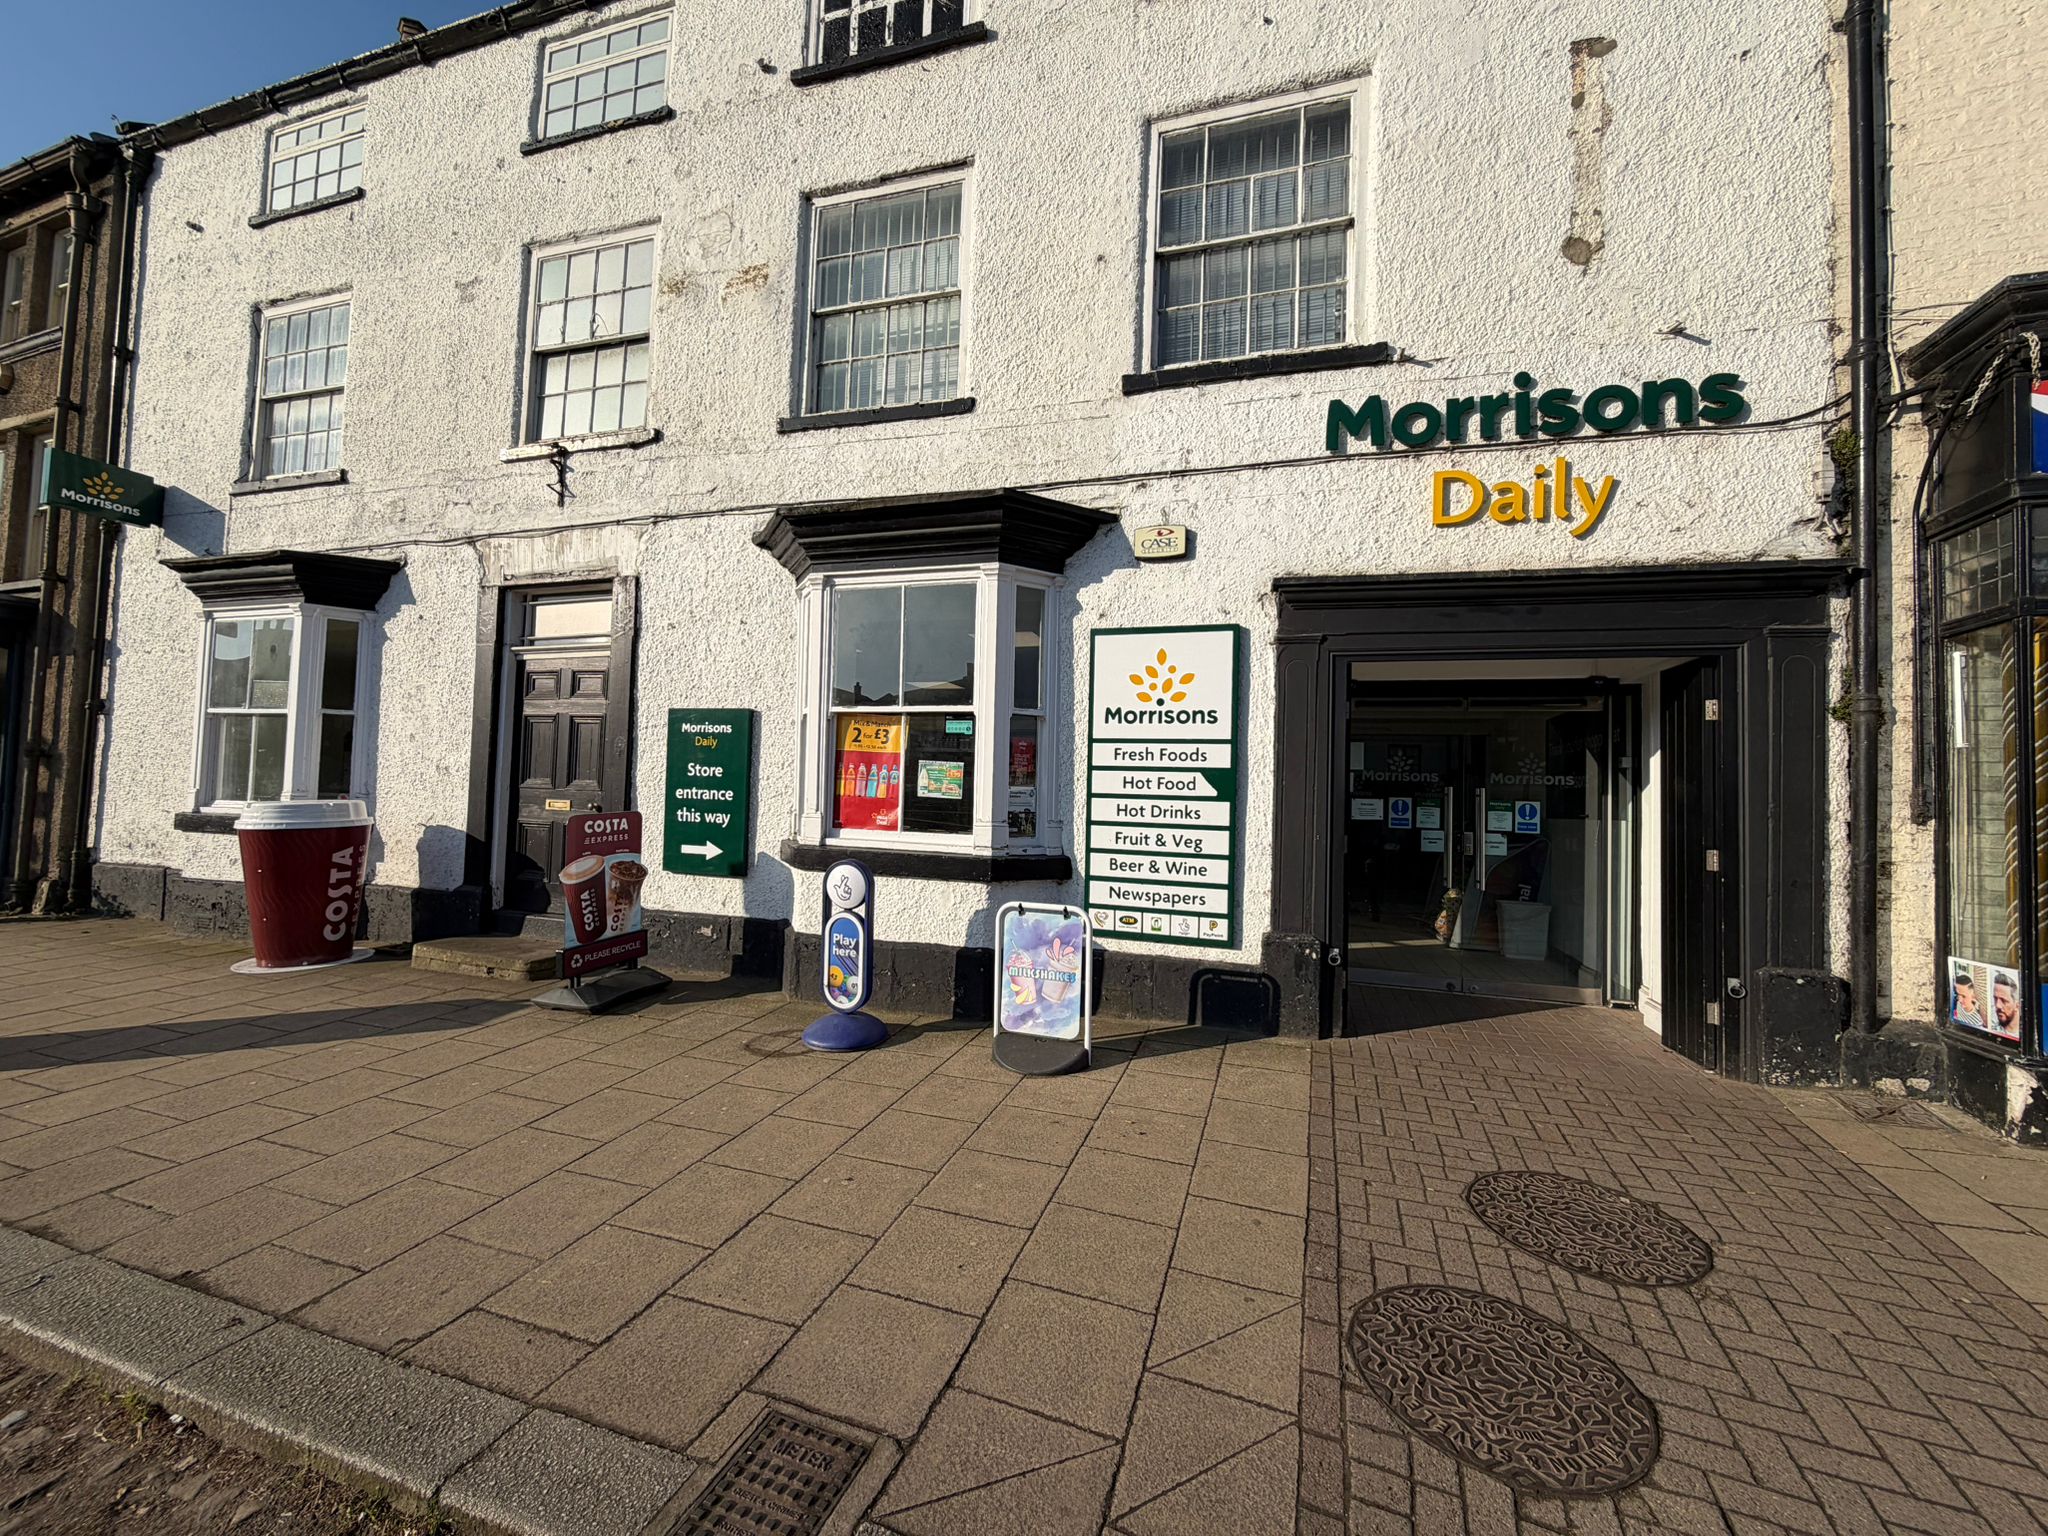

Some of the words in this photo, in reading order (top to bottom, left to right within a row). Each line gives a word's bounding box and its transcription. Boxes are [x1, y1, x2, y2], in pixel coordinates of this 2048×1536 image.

[1325, 371, 1746, 451] Morrisons
[60, 487, 141, 517] Morrisons
[1431, 456, 1615, 537] Daily
[1141, 537, 1178, 549] CASE
[1104, 698, 1219, 724] Morrisons
[681, 722, 732, 733] Morrisons
[851, 727, 862, 743] 2
[874, 728, 890, 745] £3
[695, 736, 718, 748] Daily
[1114, 747, 1154, 761] Fresh
[1159, 747, 1208, 762] Foods
[687, 763, 723, 777] Store
[1361, 769, 1440, 783] Morrisons
[1123, 776, 1152, 789] Hot
[1157, 776, 1196, 791] Food
[1489, 772, 1576, 787] Morrisons
[675, 787, 734, 801] entrance
[676, 807, 701, 823] this
[704, 812, 731, 828] way
[1117, 803, 1146, 817] Hot
[1151, 804, 1201, 820] Drinks
[583, 817, 629, 834] COSTA
[590, 833, 629, 845] EXPRESS
[1115, 832, 1150, 846] Fruit
[1155, 833, 1167, 847] &
[1172, 834, 1203, 853] Veg
[1109, 858, 1144, 872] Beer
[1148, 860, 1160, 873] &
[1165, 861, 1208, 876] Wine
[322, 845, 355, 942] COSTA
[1109, 886, 1206, 908] Newspapers
[580, 889, 595, 932] COSTA
[1122, 916, 1135, 924] ATM
[833, 932, 858, 948] Play
[584, 948, 612, 962] PLEASE
[611, 940, 641, 955] RECYCLE
[832, 946, 857, 958] here
[1007, 965, 1077, 983] MILKSHAKES
[771, 1437, 835, 1472] METER
